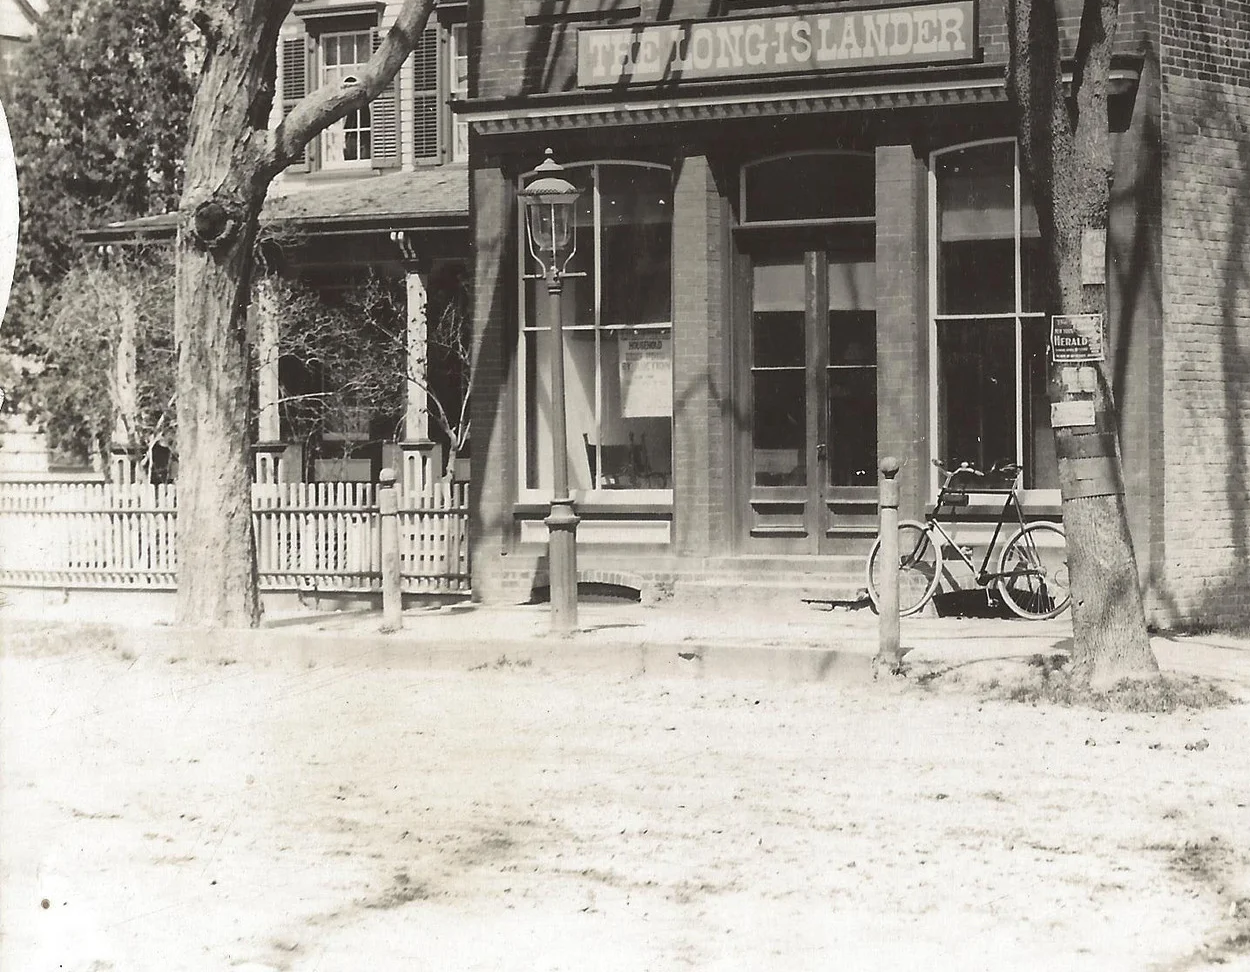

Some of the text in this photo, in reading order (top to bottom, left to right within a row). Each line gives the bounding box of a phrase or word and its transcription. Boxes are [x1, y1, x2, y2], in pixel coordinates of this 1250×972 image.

[588, 31, 660, 77] THE
[628, 340, 663, 350] HOUSEHOLD
[1054, 335, 1088, 346] HERALD
